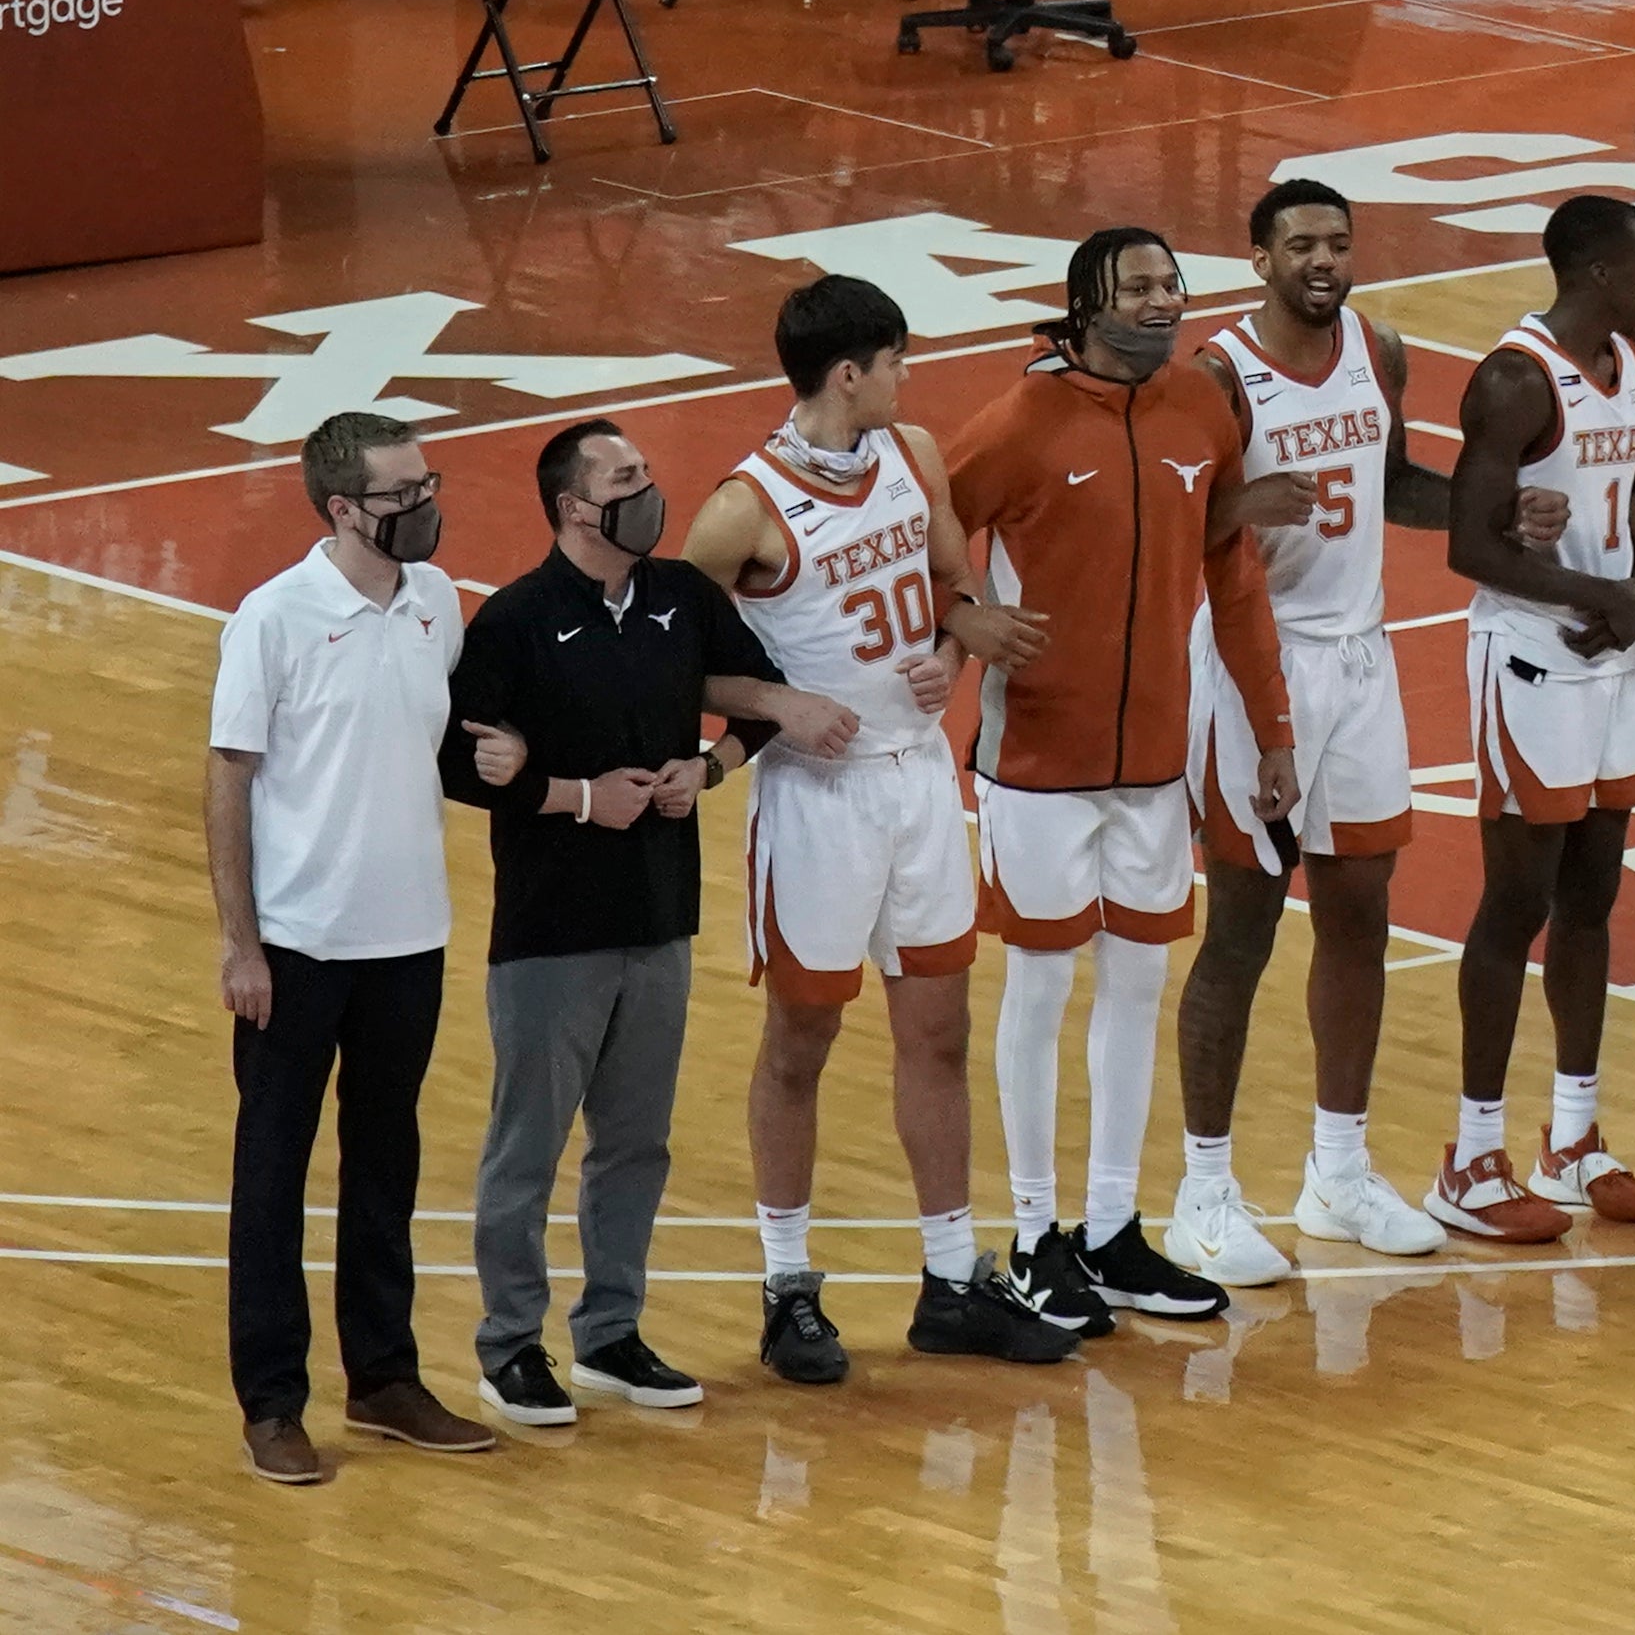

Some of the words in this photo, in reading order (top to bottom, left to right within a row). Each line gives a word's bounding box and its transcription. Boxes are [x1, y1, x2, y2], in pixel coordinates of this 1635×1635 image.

[1265, 406, 1383, 465] TEXAS
[1315, 464, 1356, 543] 5
[1602, 477, 1621, 553] 1
[812, 512, 927, 590] TEXAS
[839, 568, 935, 666] 30
